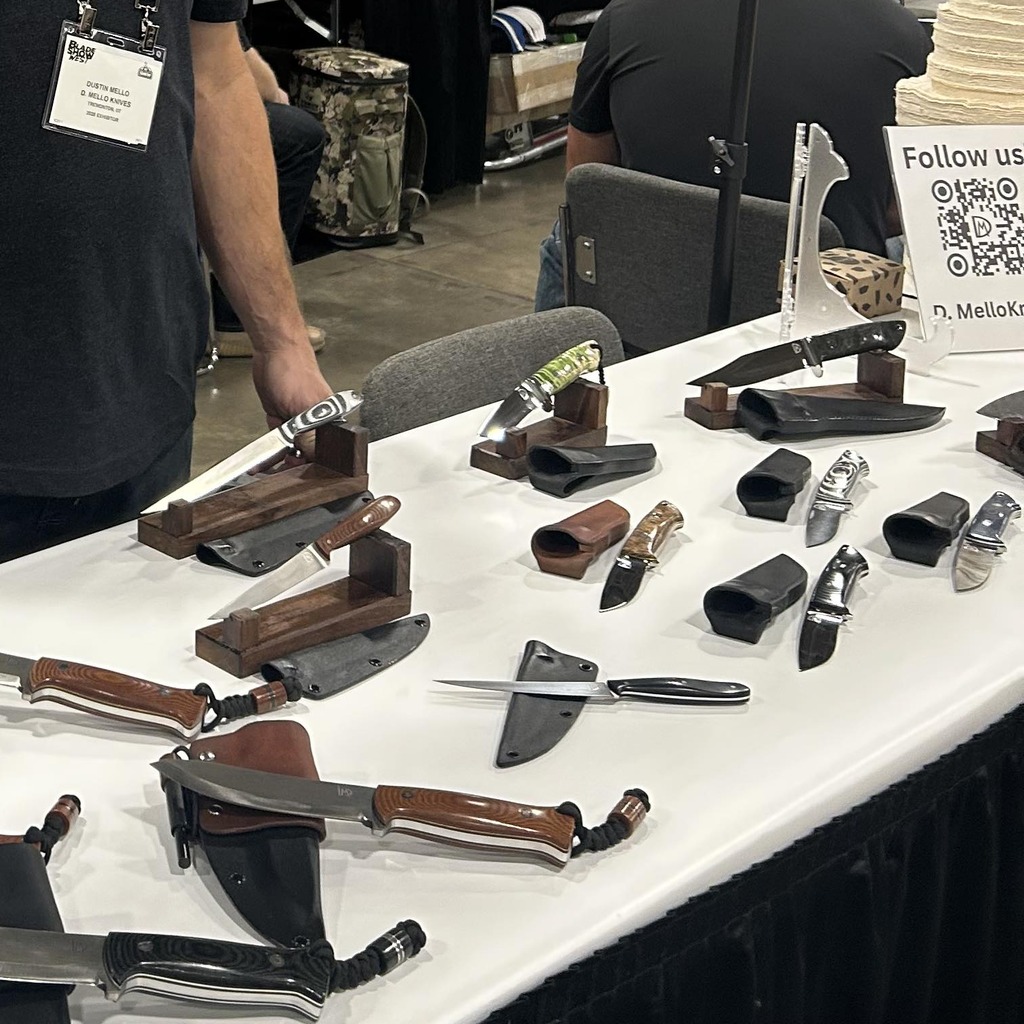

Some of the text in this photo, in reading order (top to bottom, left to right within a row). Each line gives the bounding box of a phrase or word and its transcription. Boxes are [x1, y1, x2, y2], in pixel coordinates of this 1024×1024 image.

[67, 47, 95, 60] SHOW
[86, 80, 130, 97] DUSTIN MELLO
[88, 91, 109, 102] MELLO
[109, 97, 132, 108] KNIVES
[902, 144, 1024, 169] Follow us
